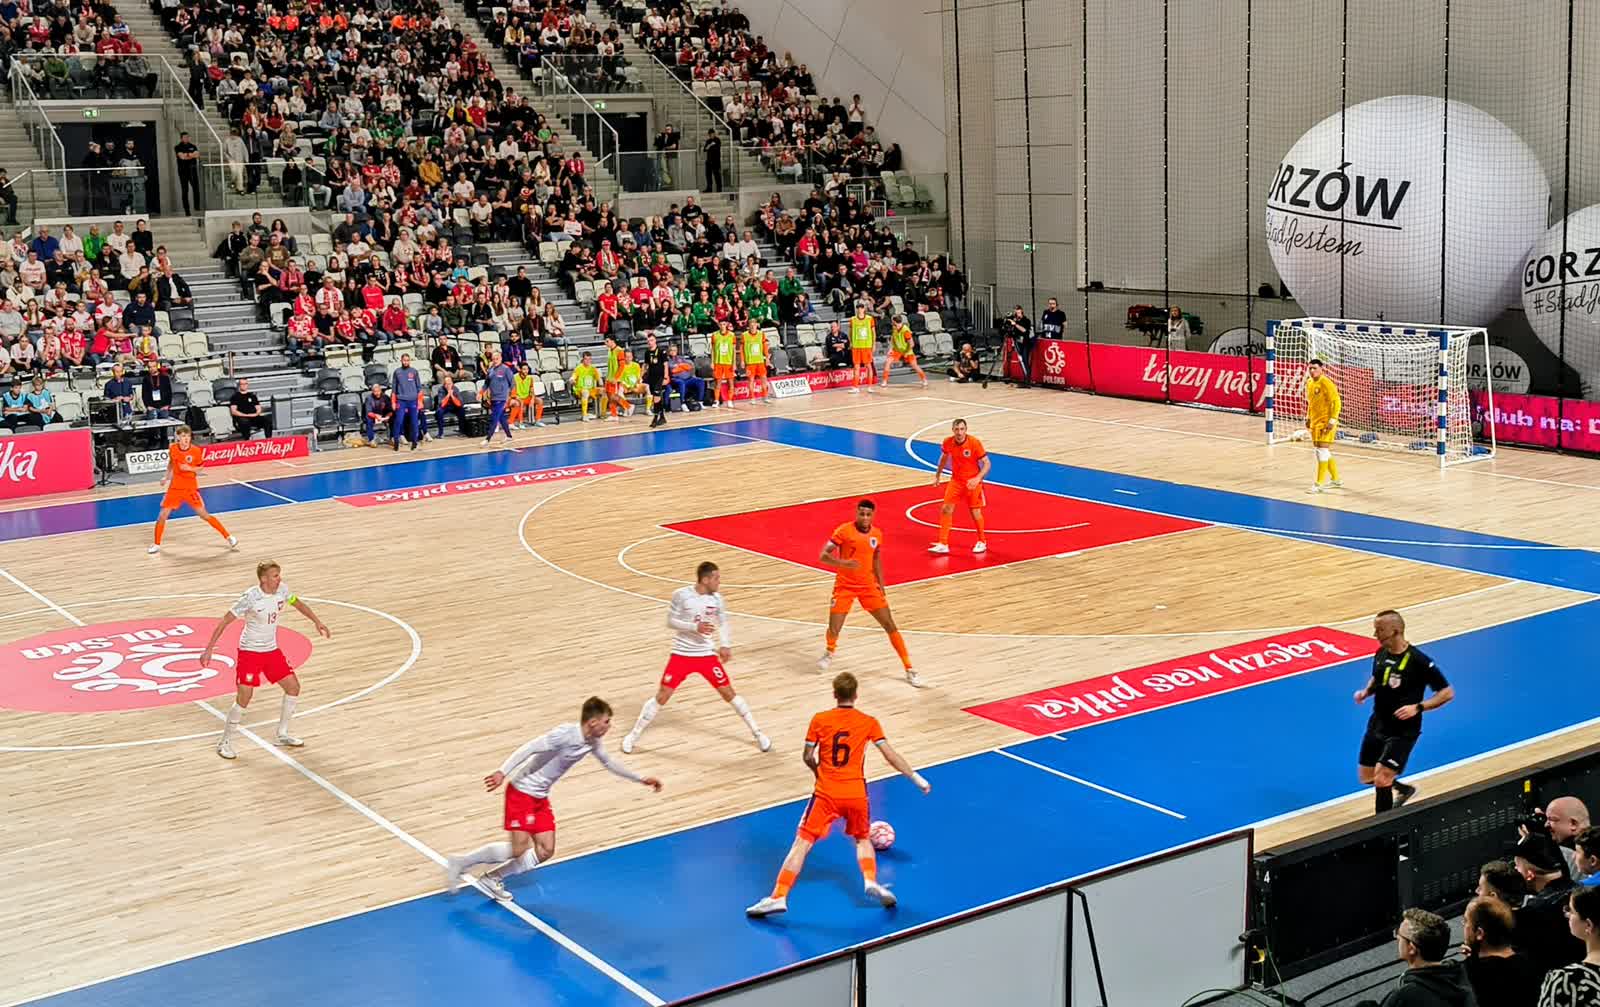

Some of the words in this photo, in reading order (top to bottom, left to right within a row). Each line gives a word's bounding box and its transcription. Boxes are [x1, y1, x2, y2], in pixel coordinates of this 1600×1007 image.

[1142, 353, 1212, 400] Łączy
[1215, 370, 1261, 396] nas
[0, 441, 39, 482] ka
[267, 612, 277, 625] 13
[19, 624, 195, 660] POLSKA
[1208, 637, 1350, 675] Łączy
[712, 666, 724, 679] 8
[1142, 665, 1223, 693] nas
[1023, 674, 1146, 719] piłka
[831, 731, 850, 768] 6
